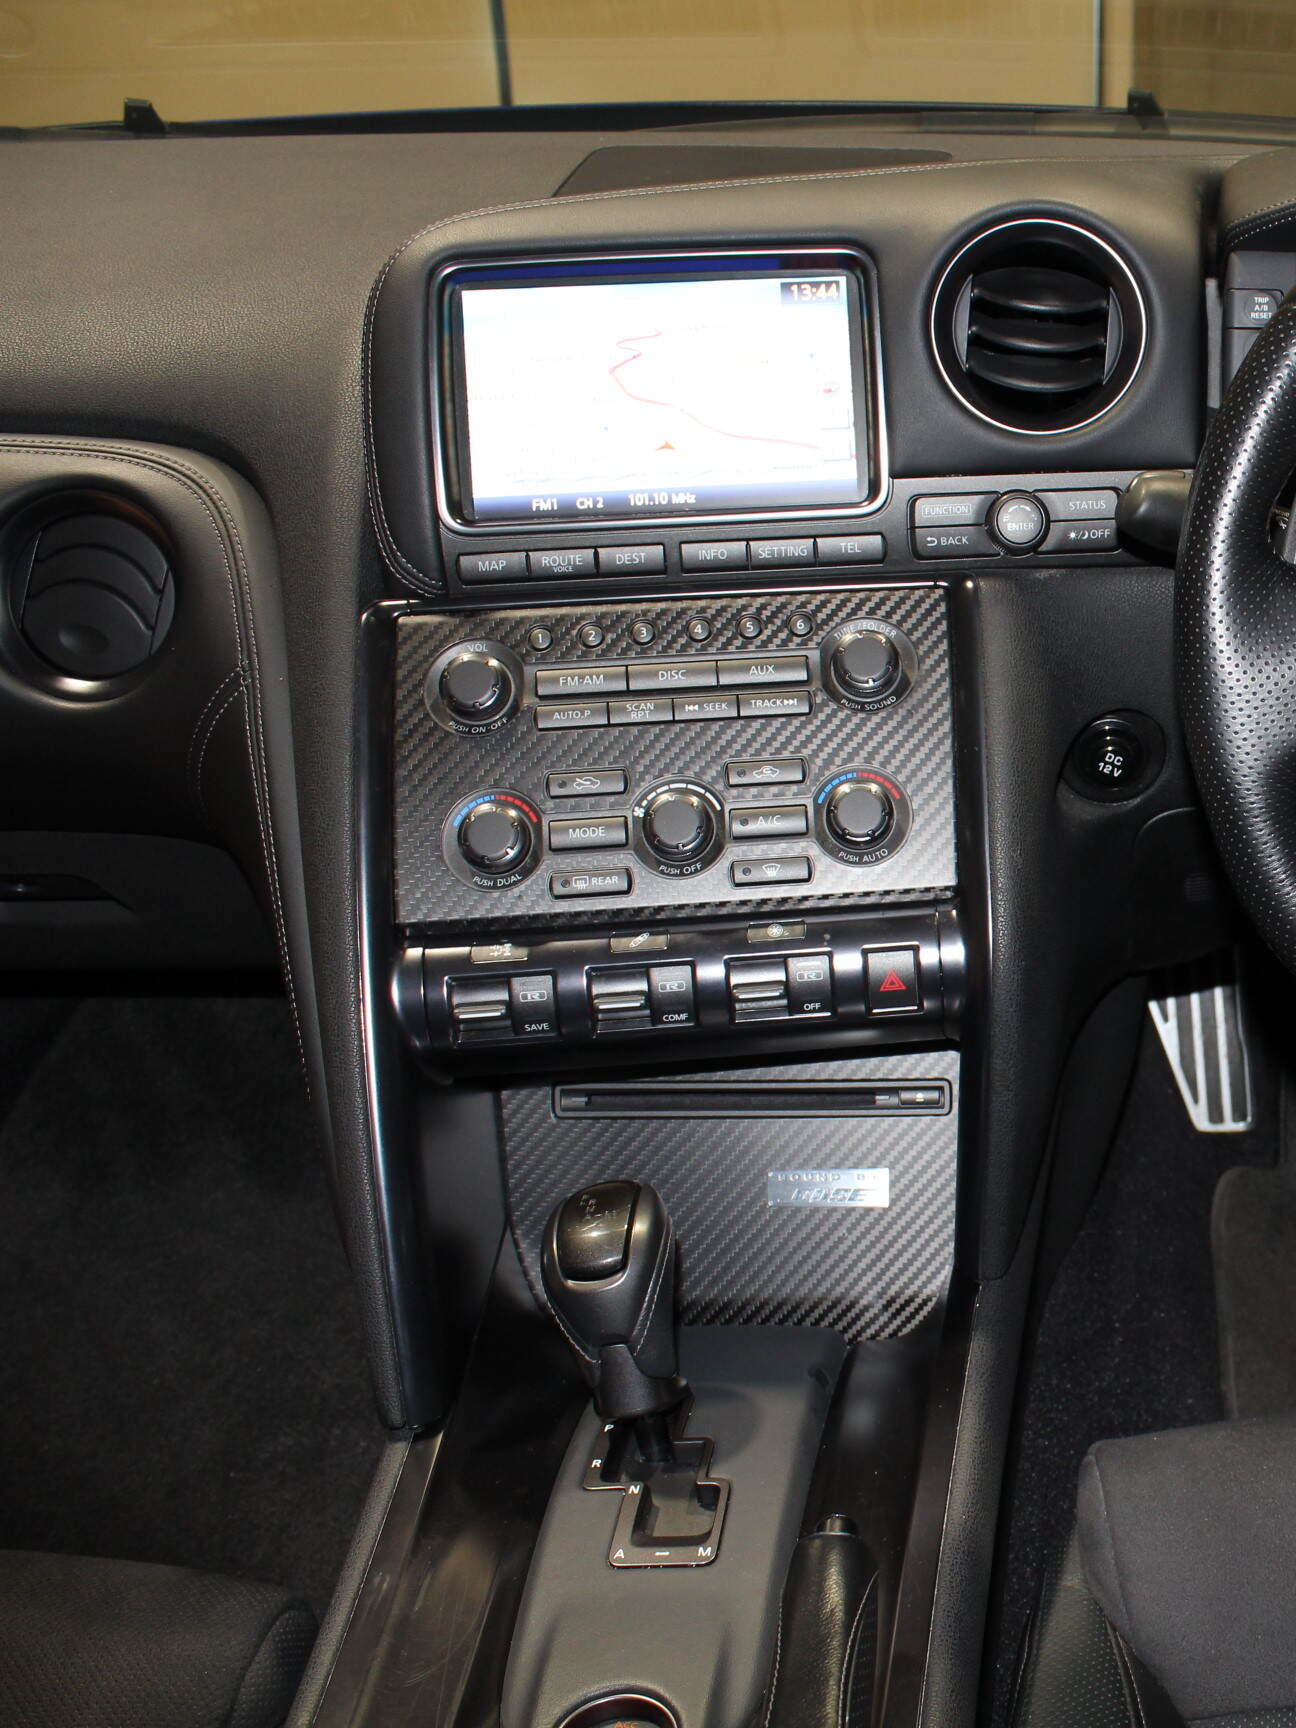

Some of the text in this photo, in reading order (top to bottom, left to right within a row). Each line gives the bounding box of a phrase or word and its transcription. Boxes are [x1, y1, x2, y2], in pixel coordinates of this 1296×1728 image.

[790, 282, 839, 301] 13:44
[1254, 296, 1269, 304] TRIP
[532, 498, 558, 511] FM1
[576, 496, 604, 509] CH 2
[628, 493, 668, 506] 101.10
[925, 505, 969, 516] FUNCTION
[1069, 500, 1107, 511] STATUS
[1007, 522, 1034, 531] ENTER
[1090, 529, 1111, 539] OFF
[940, 536, 969, 546] BACK
[758, 545, 808, 559] SETTING
[840, 542, 862, 554] TEL
[542, 554, 584, 567] ROUTE
[616, 552, 646, 565] DEST
[699, 549, 728, 561] INFO
[478, 560, 507, 572] MAP
[553, 565, 574, 573] VOICE
[693, 623, 702, 634] 4
[746, 621, 754, 632] 5
[796, 618, 805, 630] 6
[588, 630, 596, 641] 2
[639, 627, 648, 638] 3
[537, 633, 543, 644] 1
[466, 643, 488, 652] VOL
[658, 669, 687, 681] DISC
[749, 664, 776, 676] AUX
[626, 702, 654, 712] SCAN
[703, 702, 728, 712] SEEK
[750, 698, 783, 708] TRACK
[841, 695, 897, 711] PUSH SOUND
[631, 711, 650, 720] RPT
[448, 720, 468, 732] PUSH
[1104, 752, 1123, 766] DC
[757, 815, 781, 826] A/C
[569, 826, 606, 839] MODE
[838, 849, 888, 863] PUSH AUTO
[659, 863, 702, 875] PUSH OFF
[473, 873, 523, 887] PUSH DUAL
[591, 875, 619, 886] REAR
[803, 1003, 821, 1011] OFF
[663, 1013, 688, 1022] COMF
[524, 1022, 550, 1032] SAVE
[604, 1424, 614, 1432] P
[591, 1459, 602, 1468] R
[628, 1485, 640, 1494] N
[613, 1548, 625, 1559] A
[698, 1546, 712, 1557] M
